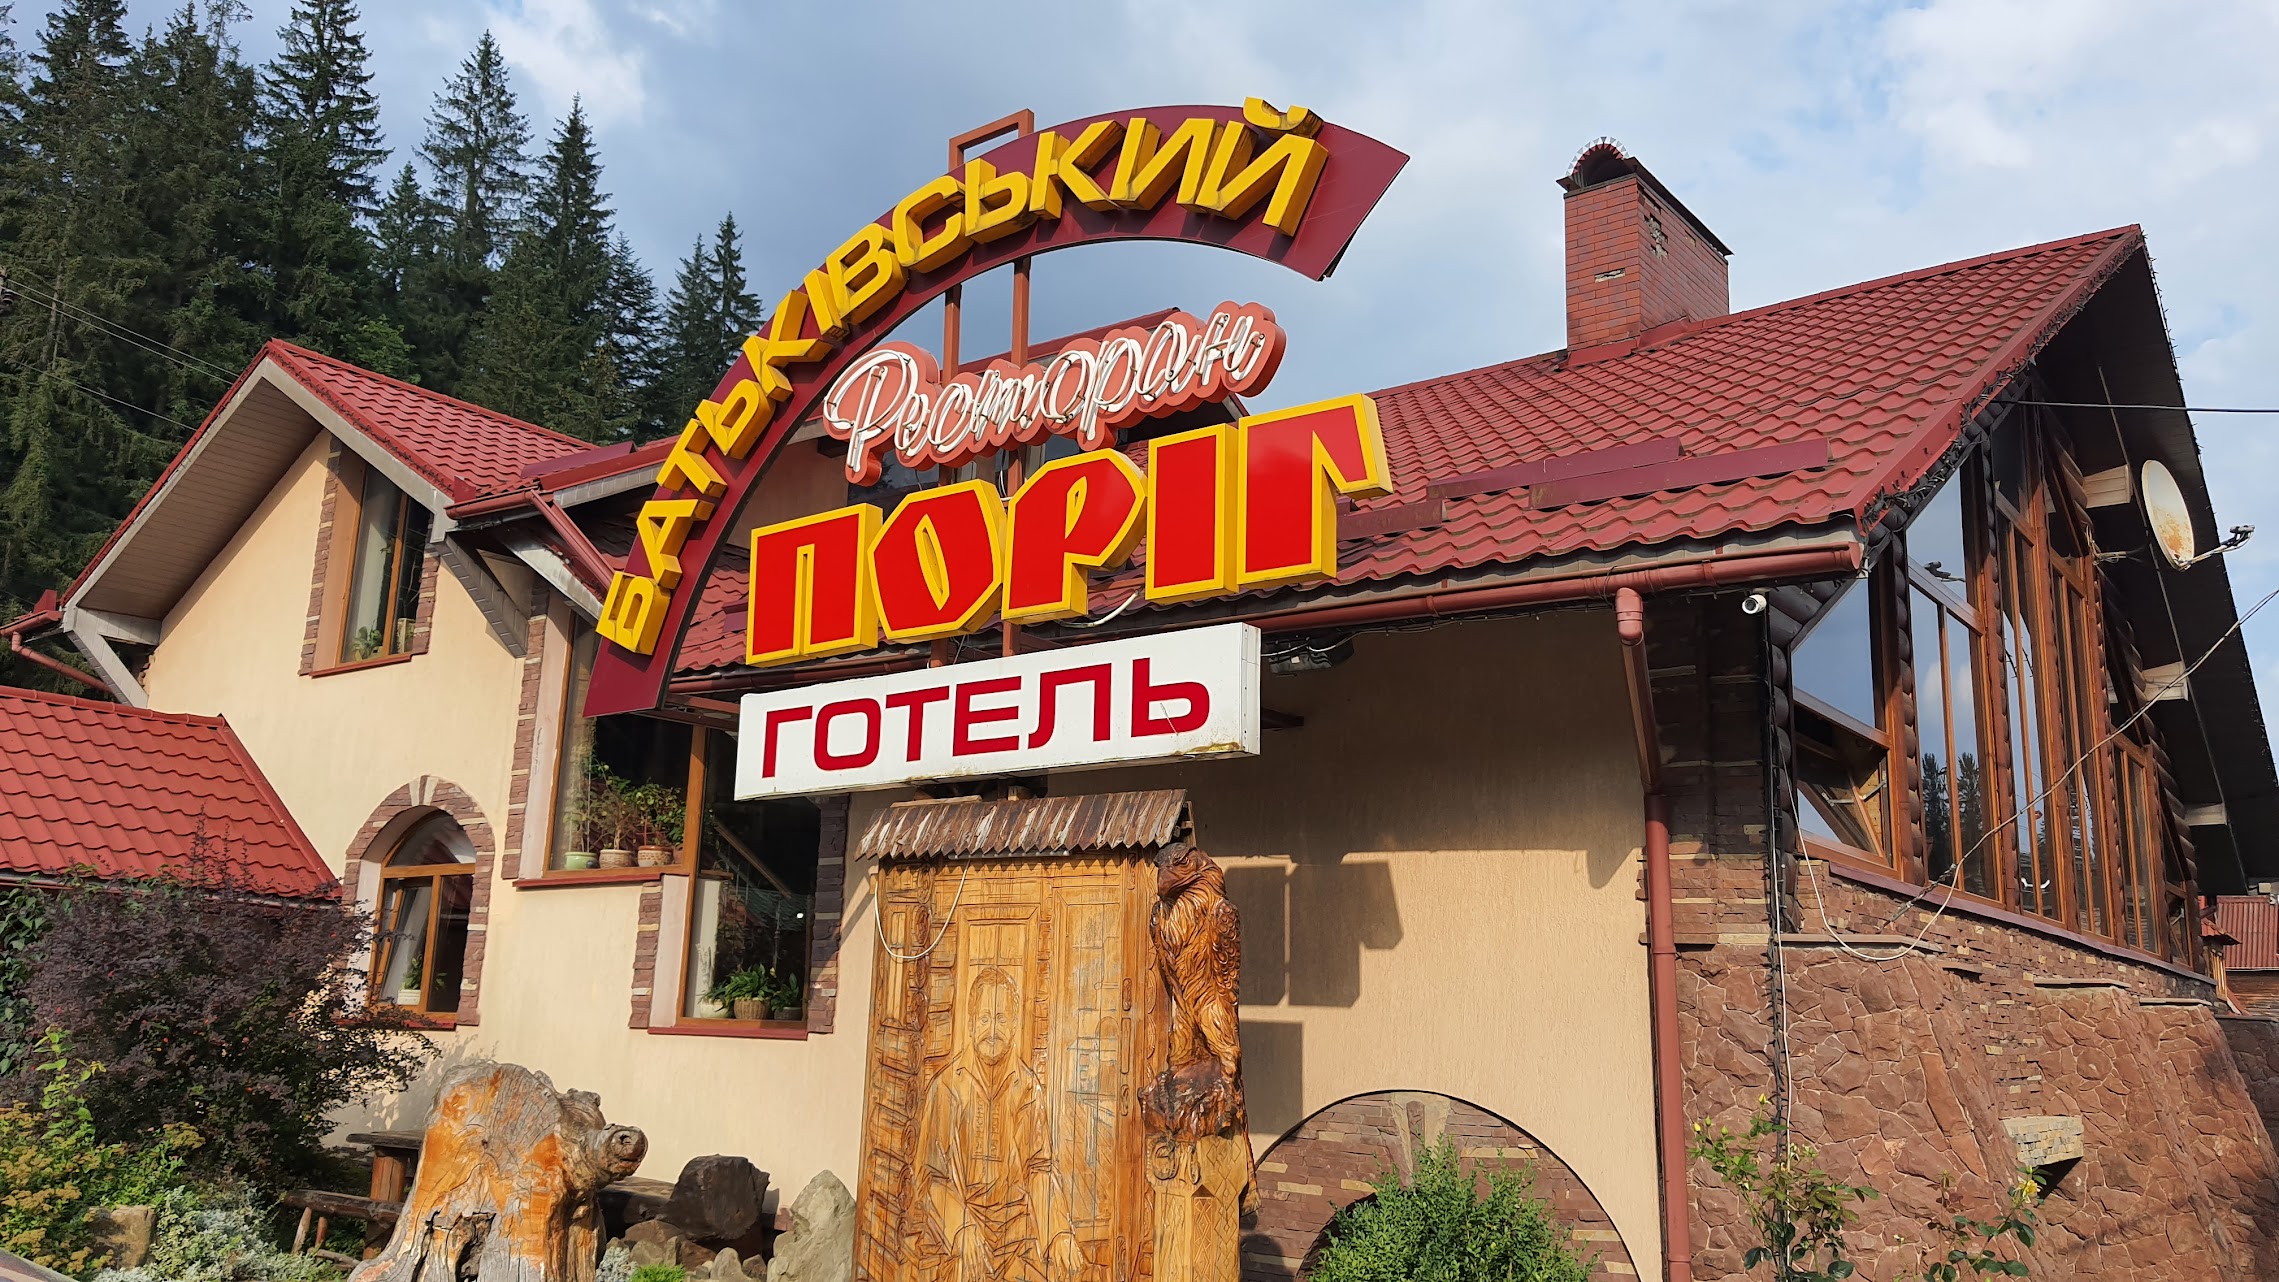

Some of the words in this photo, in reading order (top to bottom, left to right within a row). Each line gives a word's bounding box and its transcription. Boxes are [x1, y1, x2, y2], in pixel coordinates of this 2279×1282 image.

[597, 97, 1328, 655] БАТЬКІВСЬКИЙ
[824, 311, 1266, 474] Ресторан
[745, 393, 1394, 666] ПОРІГ
[762, 657, 1211, 779] ГОТЕЛЬ
